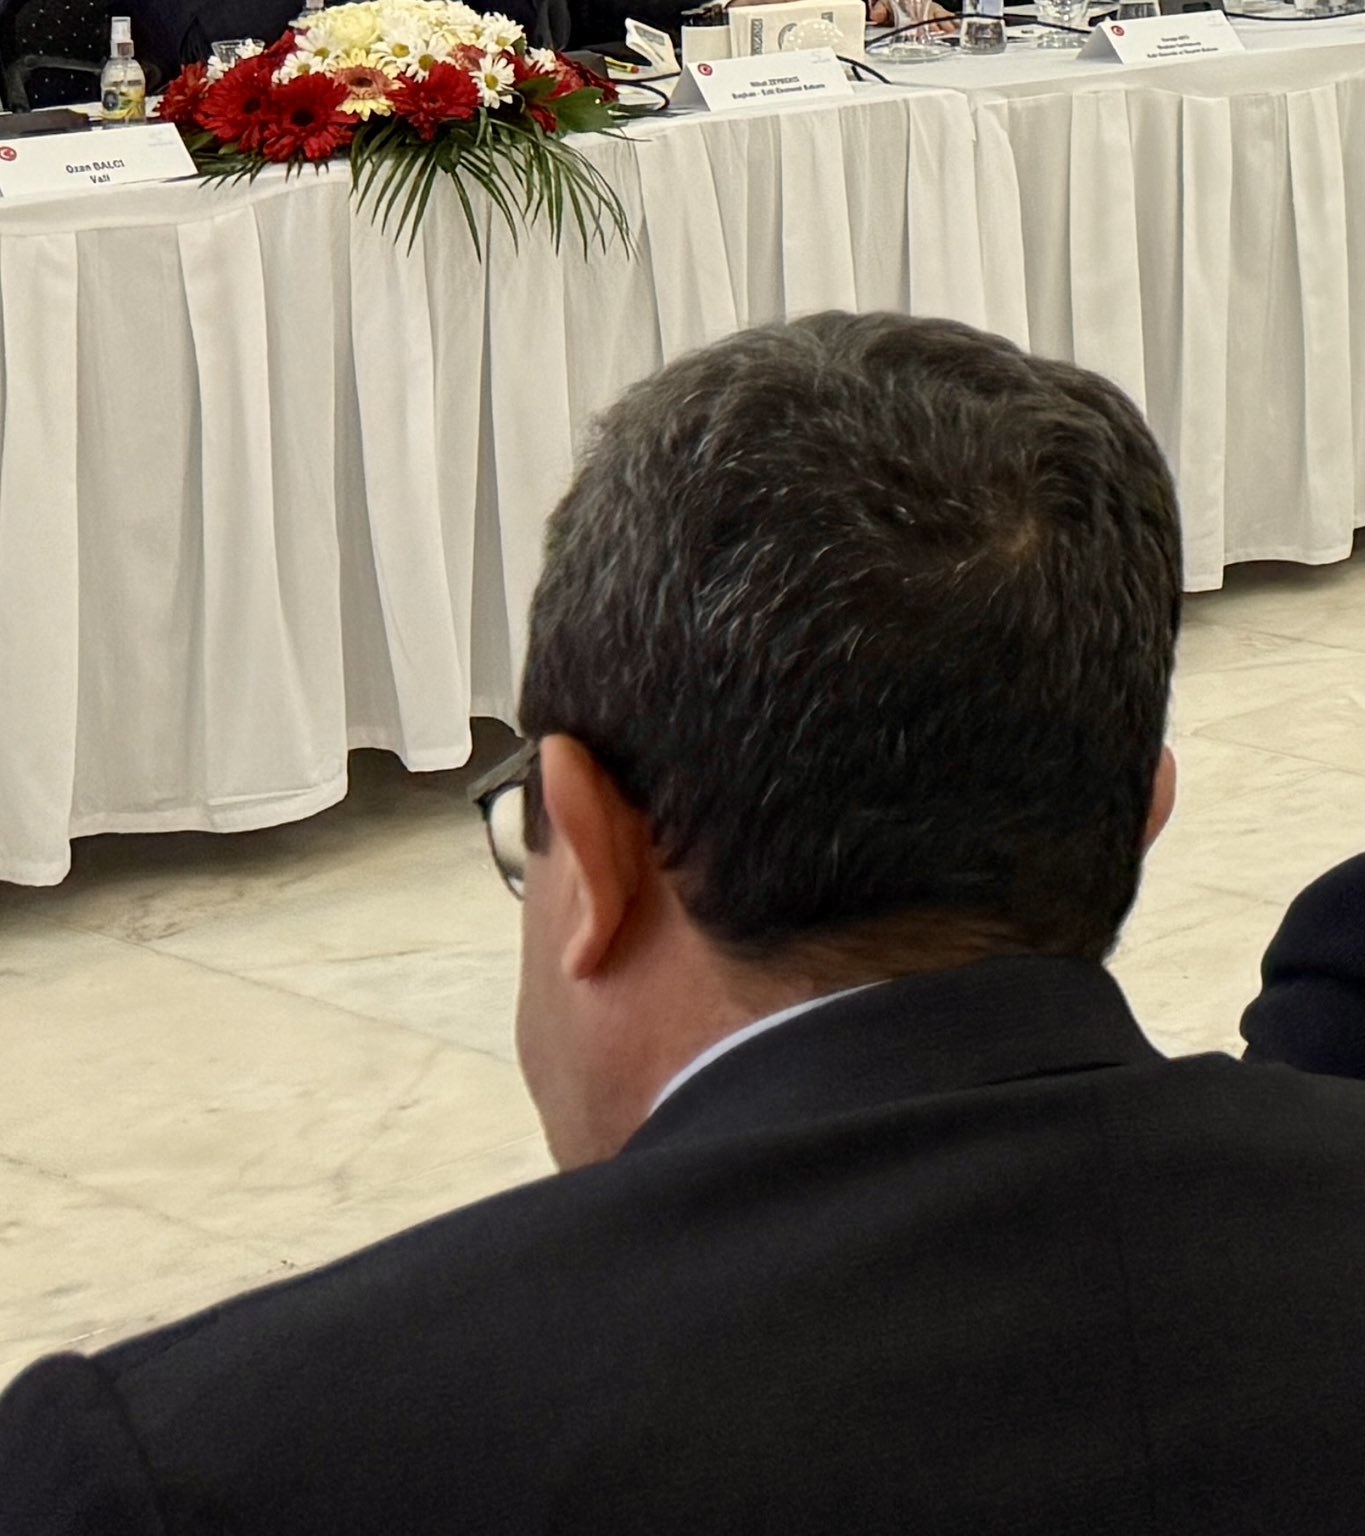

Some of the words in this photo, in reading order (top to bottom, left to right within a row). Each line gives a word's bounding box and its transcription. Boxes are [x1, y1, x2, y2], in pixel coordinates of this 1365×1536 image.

[66, 165, 91, 174] Ozan
[93, 160, 125, 170] BALCI
[90, 174, 110, 184] Vali
